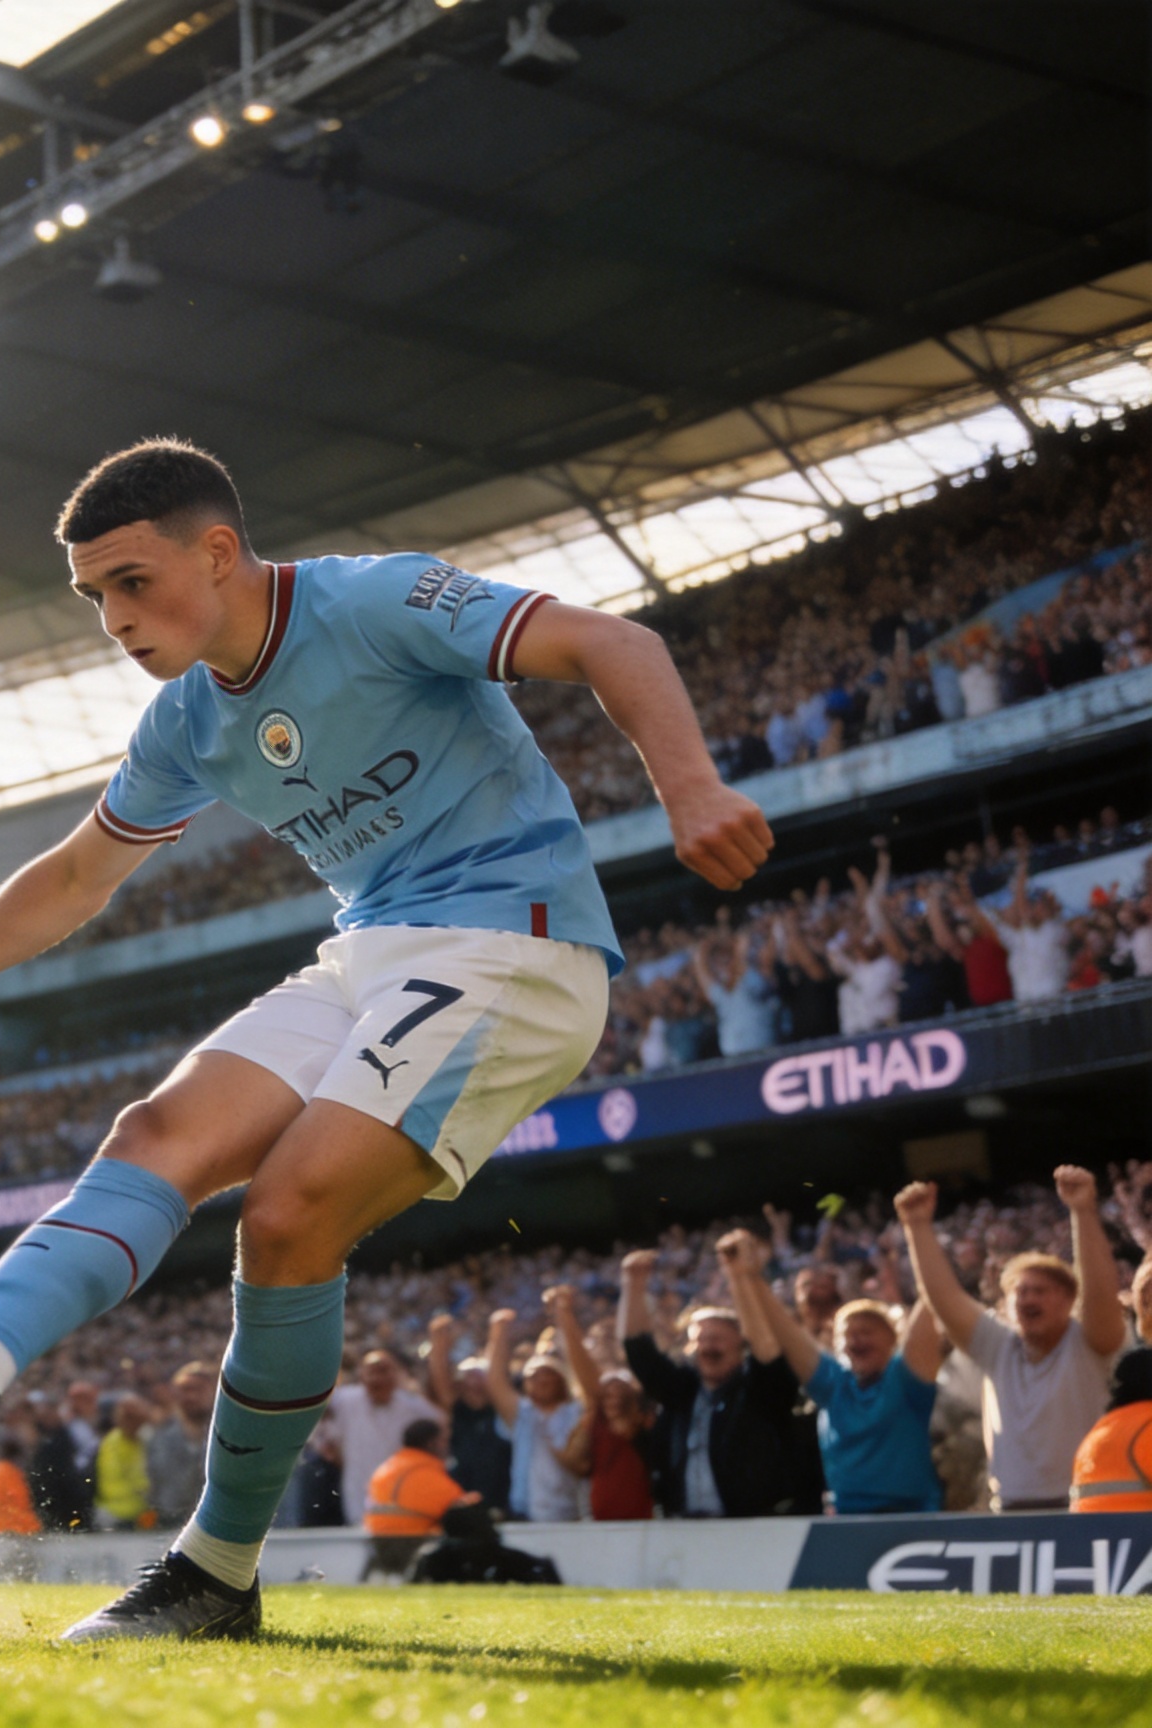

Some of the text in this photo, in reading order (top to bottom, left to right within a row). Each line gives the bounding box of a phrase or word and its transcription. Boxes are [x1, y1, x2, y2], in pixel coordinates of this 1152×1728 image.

[272, 750, 420, 844] TIHAD
[380, 979, 465, 1048] 7
[762, 1029, 966, 1114] ETIHAD
